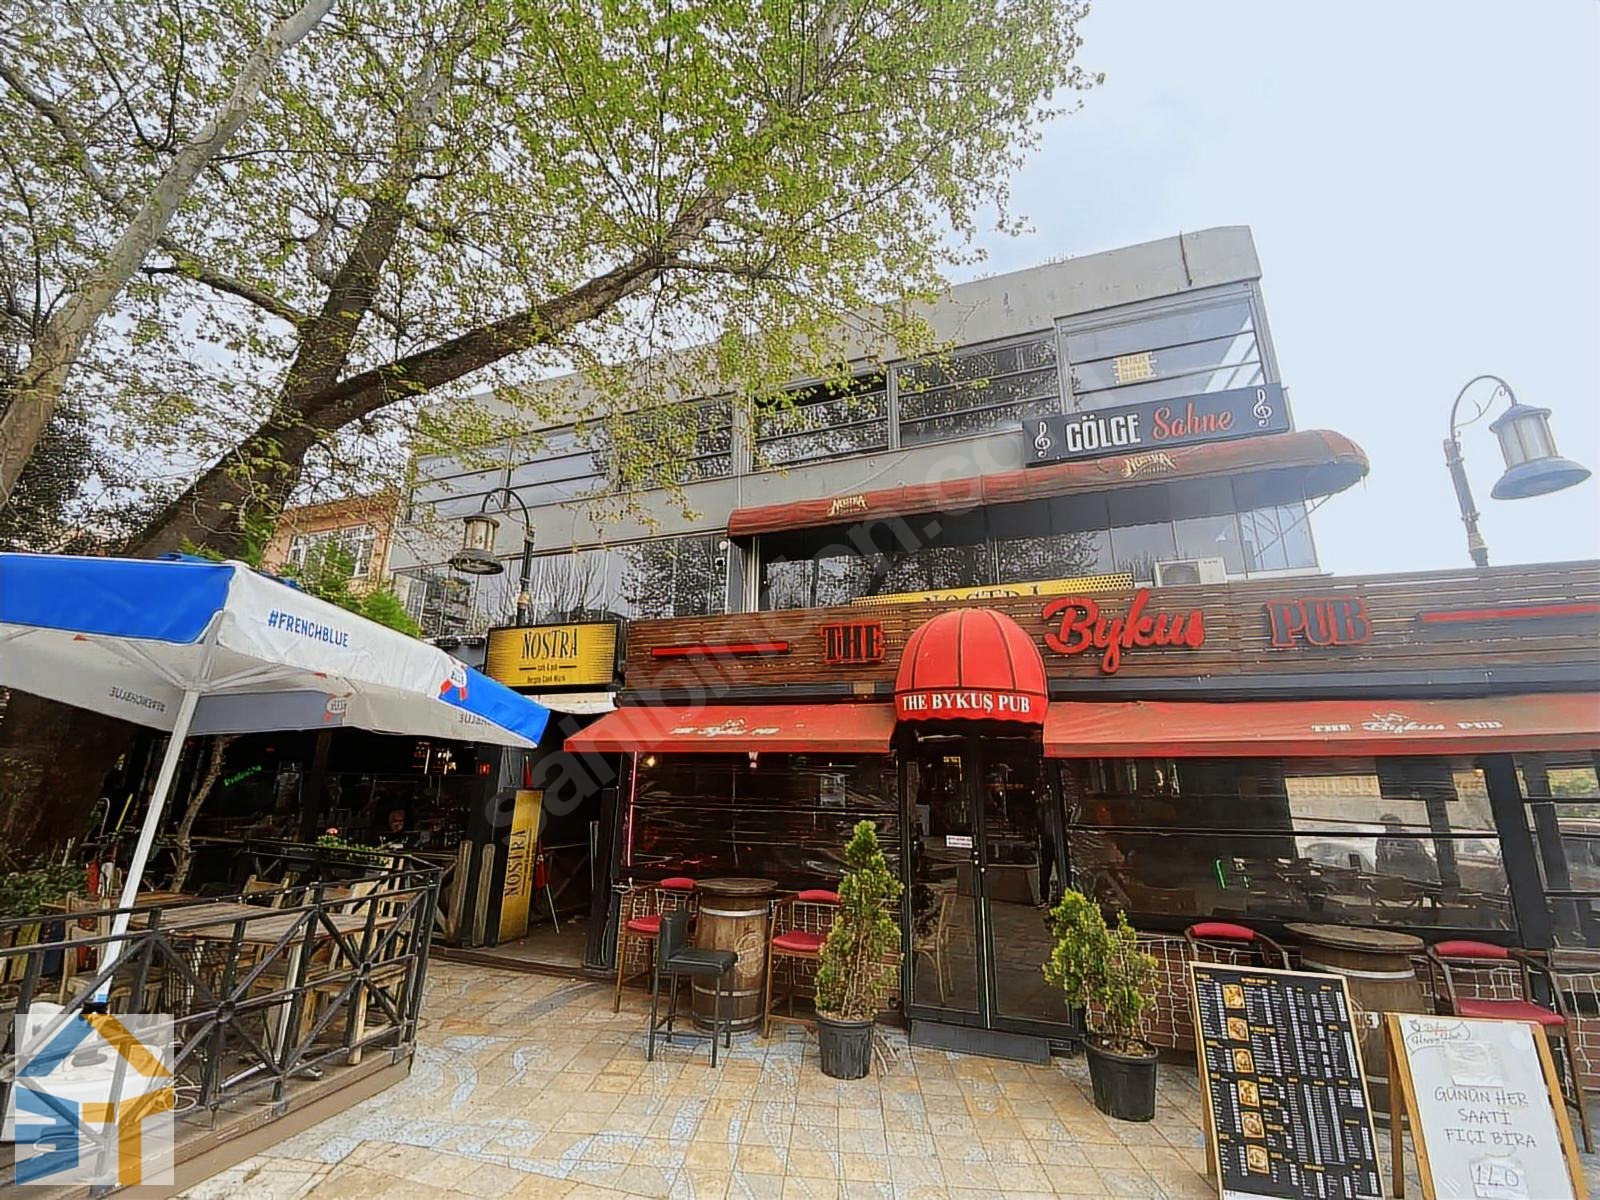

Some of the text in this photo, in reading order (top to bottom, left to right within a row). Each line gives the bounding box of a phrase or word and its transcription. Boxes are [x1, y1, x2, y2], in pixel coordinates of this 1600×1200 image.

[1065, 403, 1234, 452] GÖLGE Sahne
[268, 610, 348, 647] #FRENCHBLUE
[820, 620, 885, 666] THE
[1266, 596, 1373, 649] PUB
[522, 628, 577, 659] NOSTRA
[903, 692, 1031, 713] THE BYKUŞ PUB
[1311, 723, 1351, 733] THE
[1456, 721, 1503, 730] PUB
[504, 830, 527, 897] NOSTRA
[1434, 1087, 1529, 1106] GÜNÜN HER
[1458, 1108, 1512, 1125] SAATİ
[1490, 1129, 1538, 1147] BİRA
